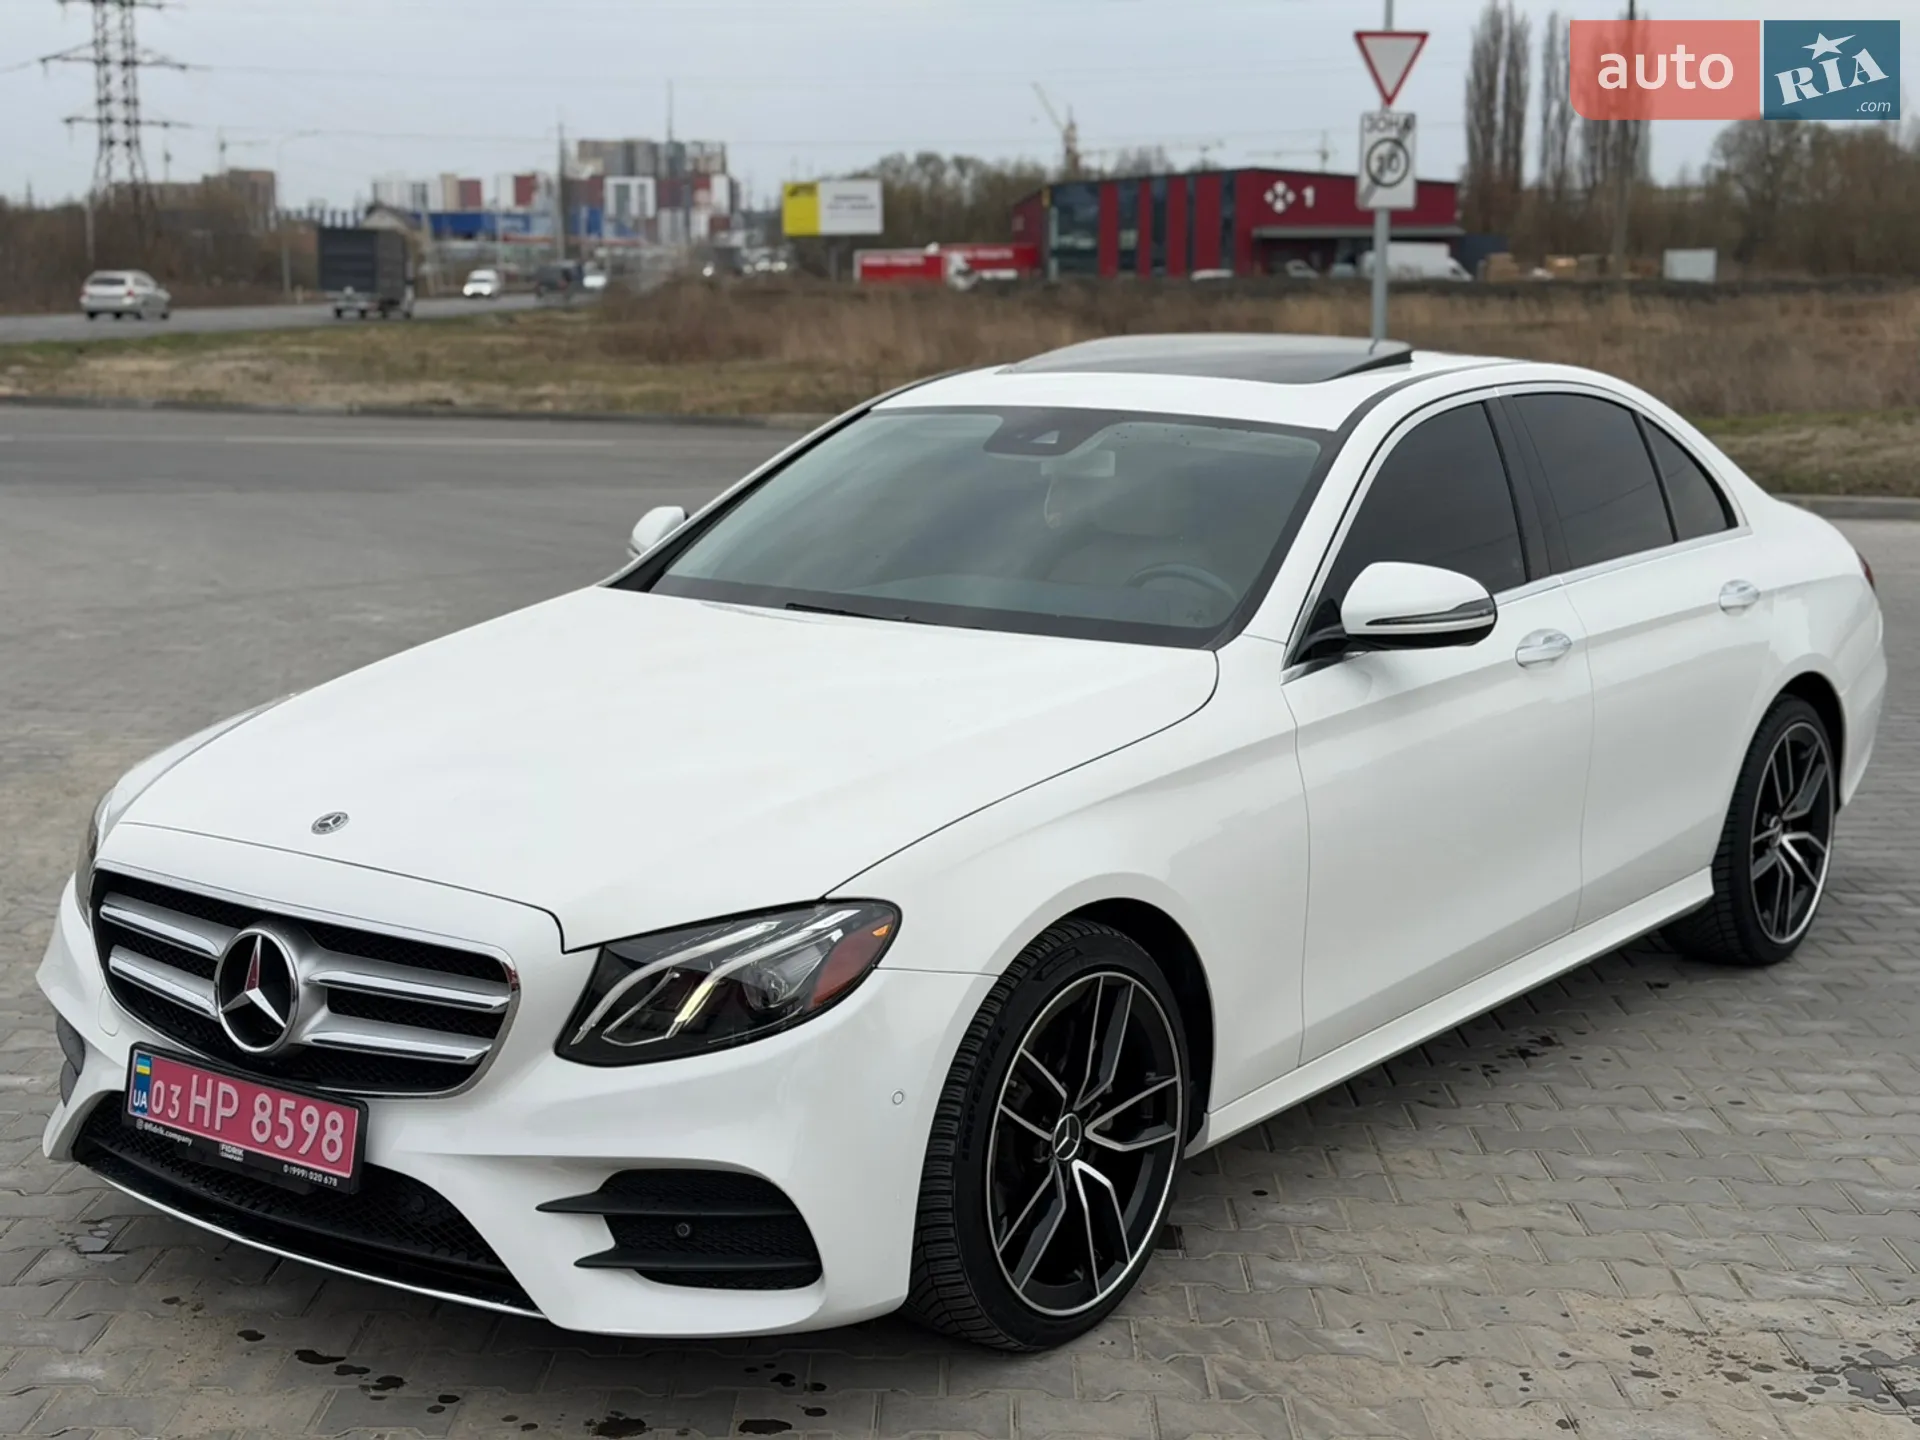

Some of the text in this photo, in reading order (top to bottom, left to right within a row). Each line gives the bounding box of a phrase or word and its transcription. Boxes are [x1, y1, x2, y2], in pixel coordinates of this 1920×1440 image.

[1301, 185, 1316, 210] 1
[132, 1089, 148, 1109] UA
[151, 1080, 182, 1120] 03
[251, 1092, 344, 1163] 8598
[308, 1170, 324, 1183] 020
